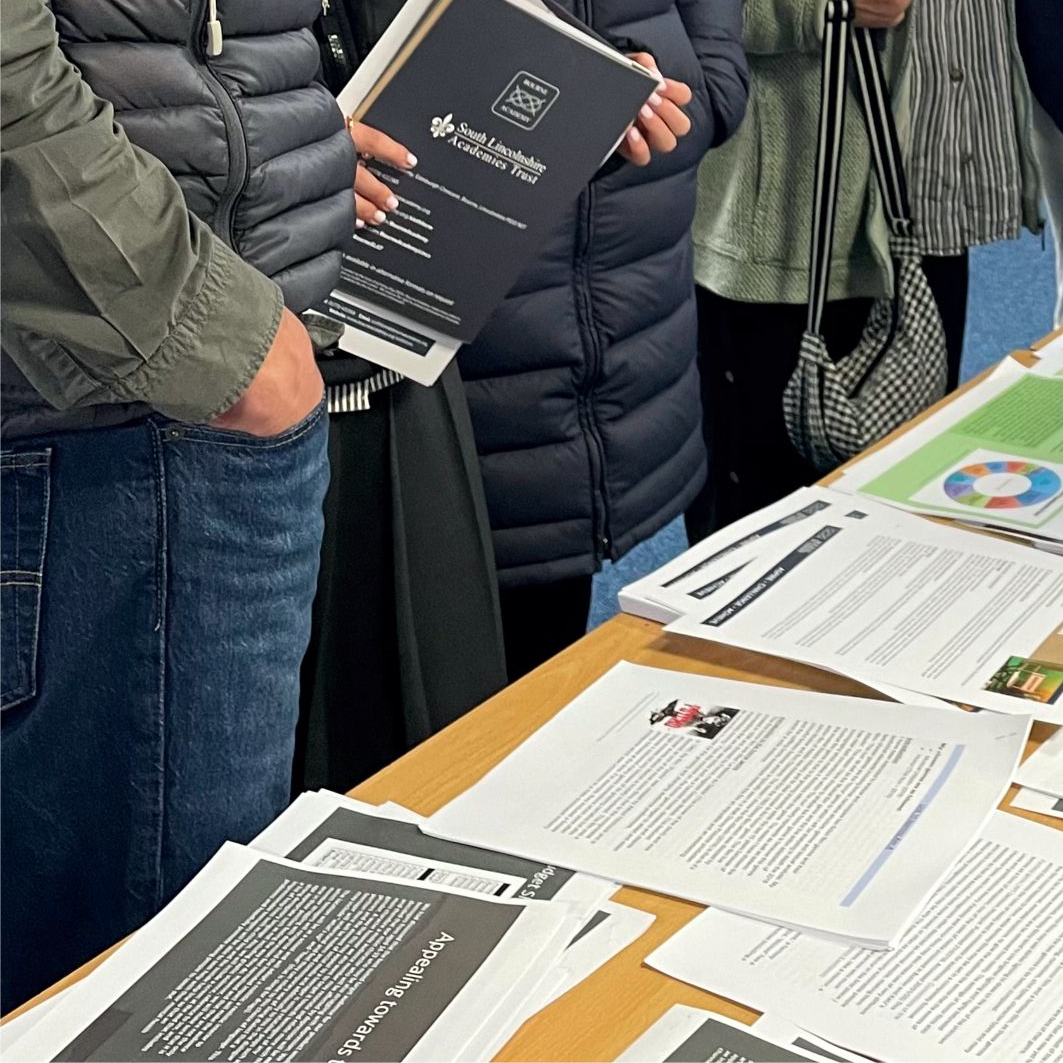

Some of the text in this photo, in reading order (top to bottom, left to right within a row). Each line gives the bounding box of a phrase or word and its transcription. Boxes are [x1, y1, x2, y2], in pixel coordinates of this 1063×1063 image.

[448, 135, 539, 185] Academies Trust
[457, 122, 547, 174] South Lincolnshire
[337, 931, 455, 1057] Appealing towards
